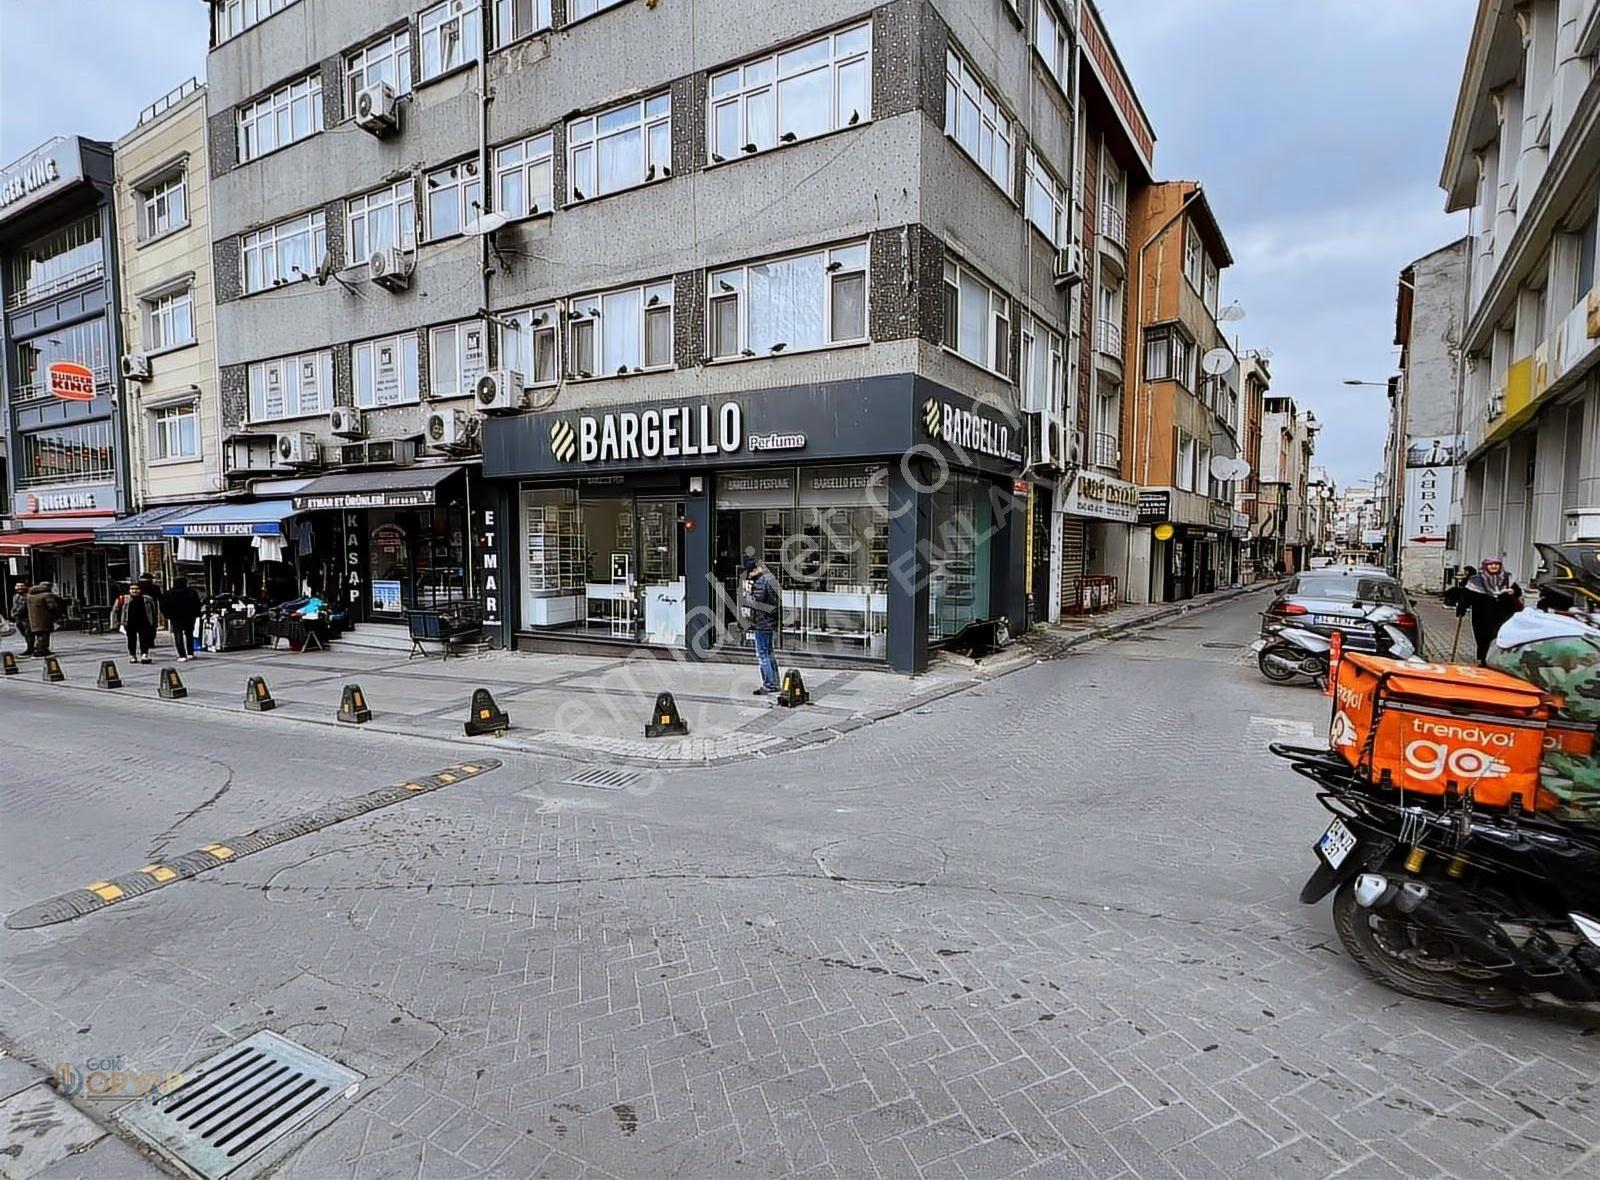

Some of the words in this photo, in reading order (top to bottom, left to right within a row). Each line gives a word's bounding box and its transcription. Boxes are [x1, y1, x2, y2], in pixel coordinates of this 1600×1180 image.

[23, 157, 58, 194] KING
[51, 372, 93, 384] BURGER
[51, 380, 94, 393] KING
[580, 401, 742, 463] BARGELLO
[749, 433, 806, 451] Perfume
[943, 403, 1008, 458] BARGELLO
[1412, 718, 1516, 747] trendyol
[1405, 739, 1510, 781] go
